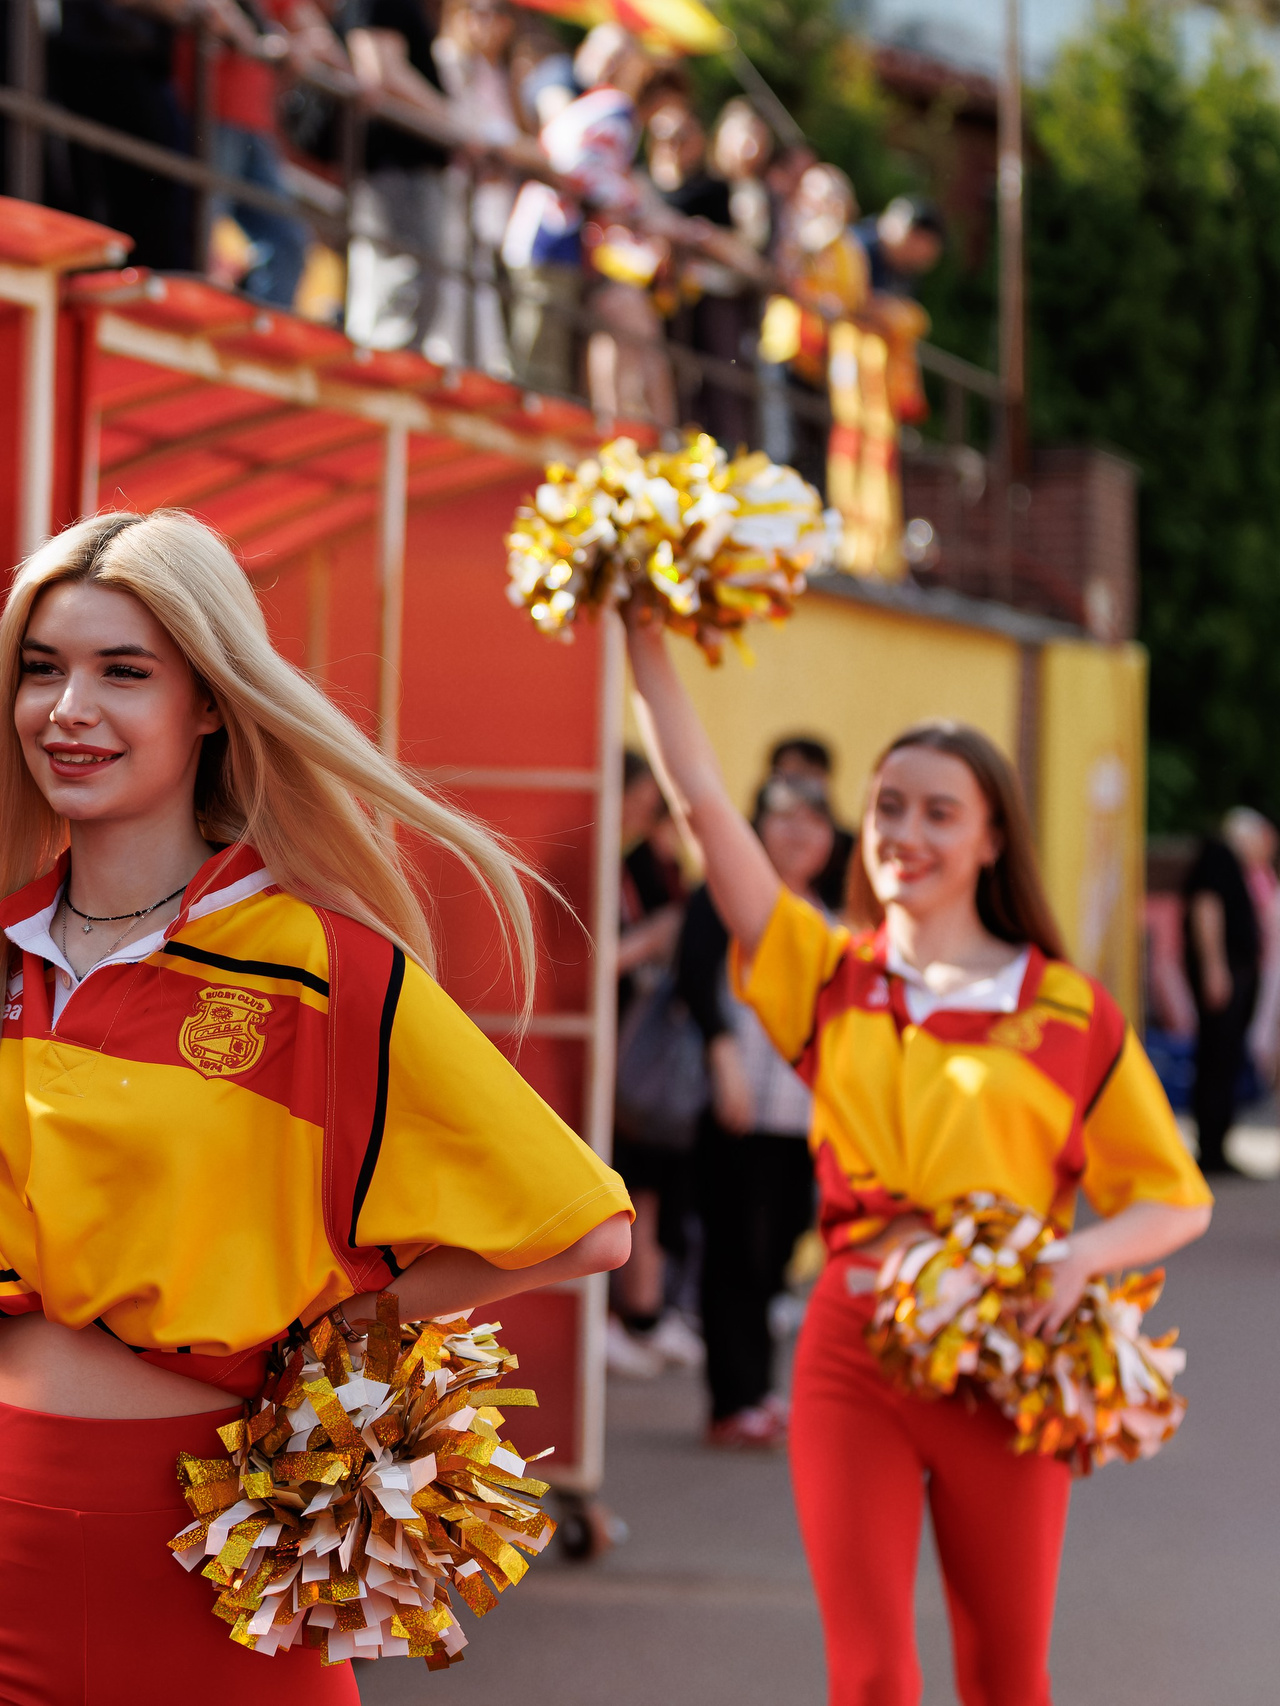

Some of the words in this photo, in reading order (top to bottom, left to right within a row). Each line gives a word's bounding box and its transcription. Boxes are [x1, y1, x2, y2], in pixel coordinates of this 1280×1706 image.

[205, 990, 237, 1000] RUGBY
[237, 993, 265, 1011] CLUB
[199, 1059, 223, 1073] 1974
